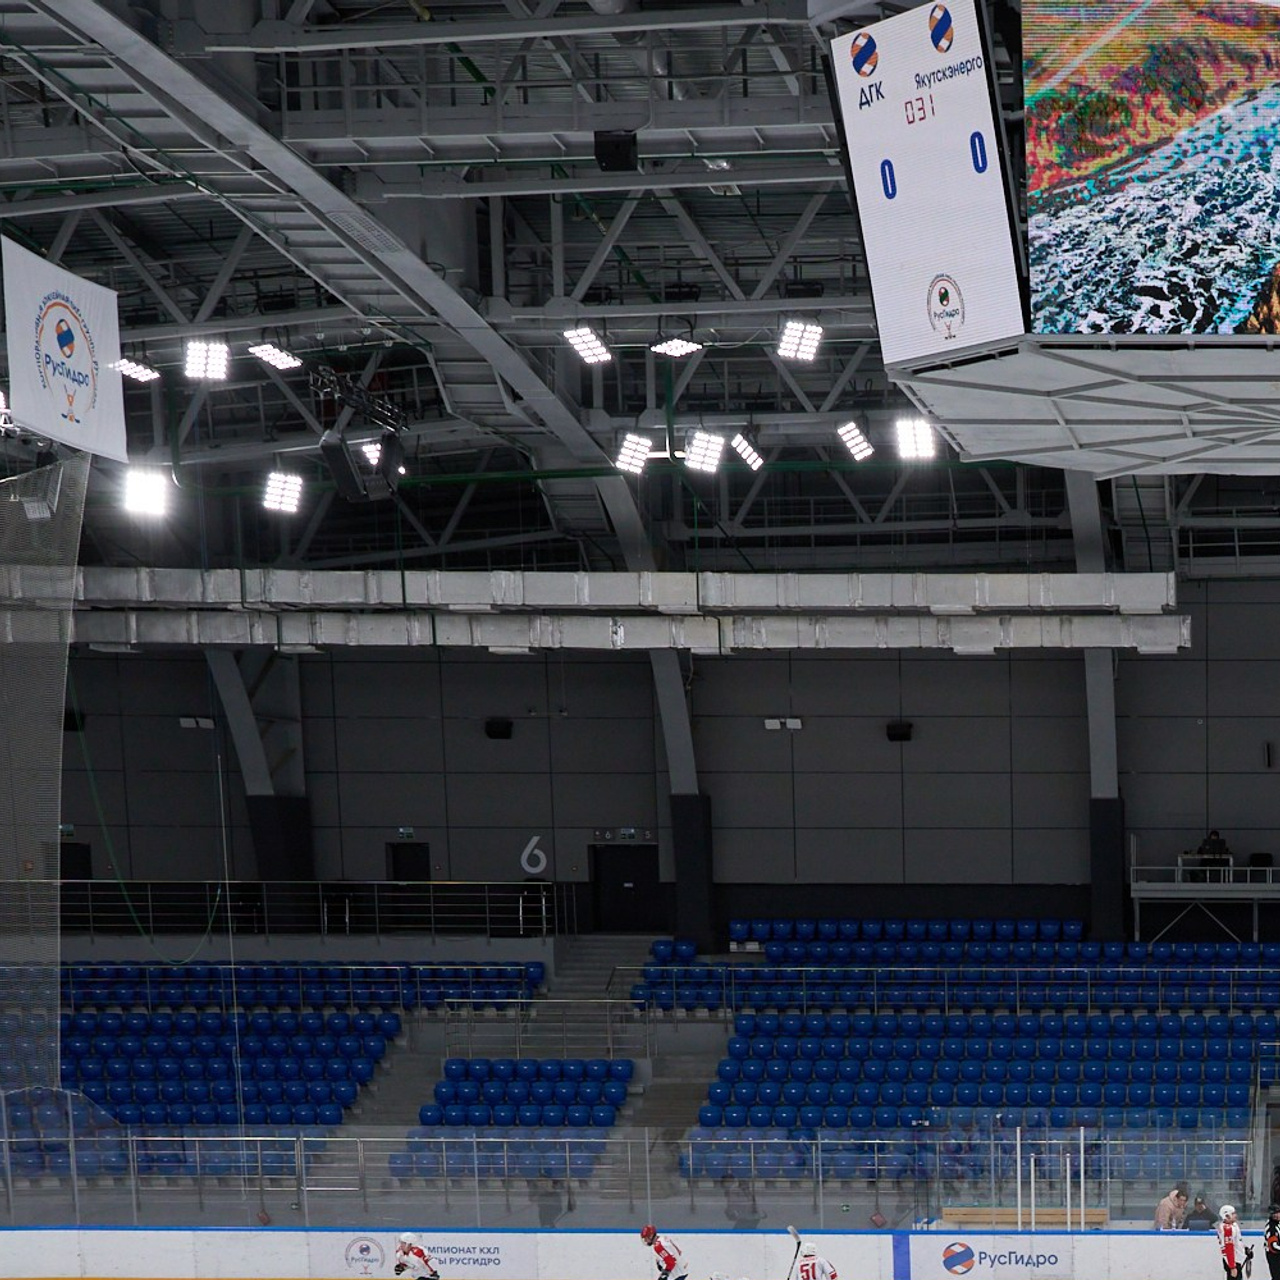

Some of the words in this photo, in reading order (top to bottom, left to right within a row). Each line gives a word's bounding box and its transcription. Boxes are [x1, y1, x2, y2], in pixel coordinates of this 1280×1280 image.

[914, 55, 983, 90] Якутскэнерго
[858, 81, 885, 110] ДГК
[970, 131, 988, 173] 0
[880, 159, 897, 199] 0
[44, 353, 90, 387] РусГидро
[520, 835, 548, 874] 6
[449, 1257, 500, 1266] РУСГИДРО
[479, 1246, 500, 1255] КХЛ
[978, 1251, 1058, 1269] РусГидро
[800, 1262, 817, 1280] 51
